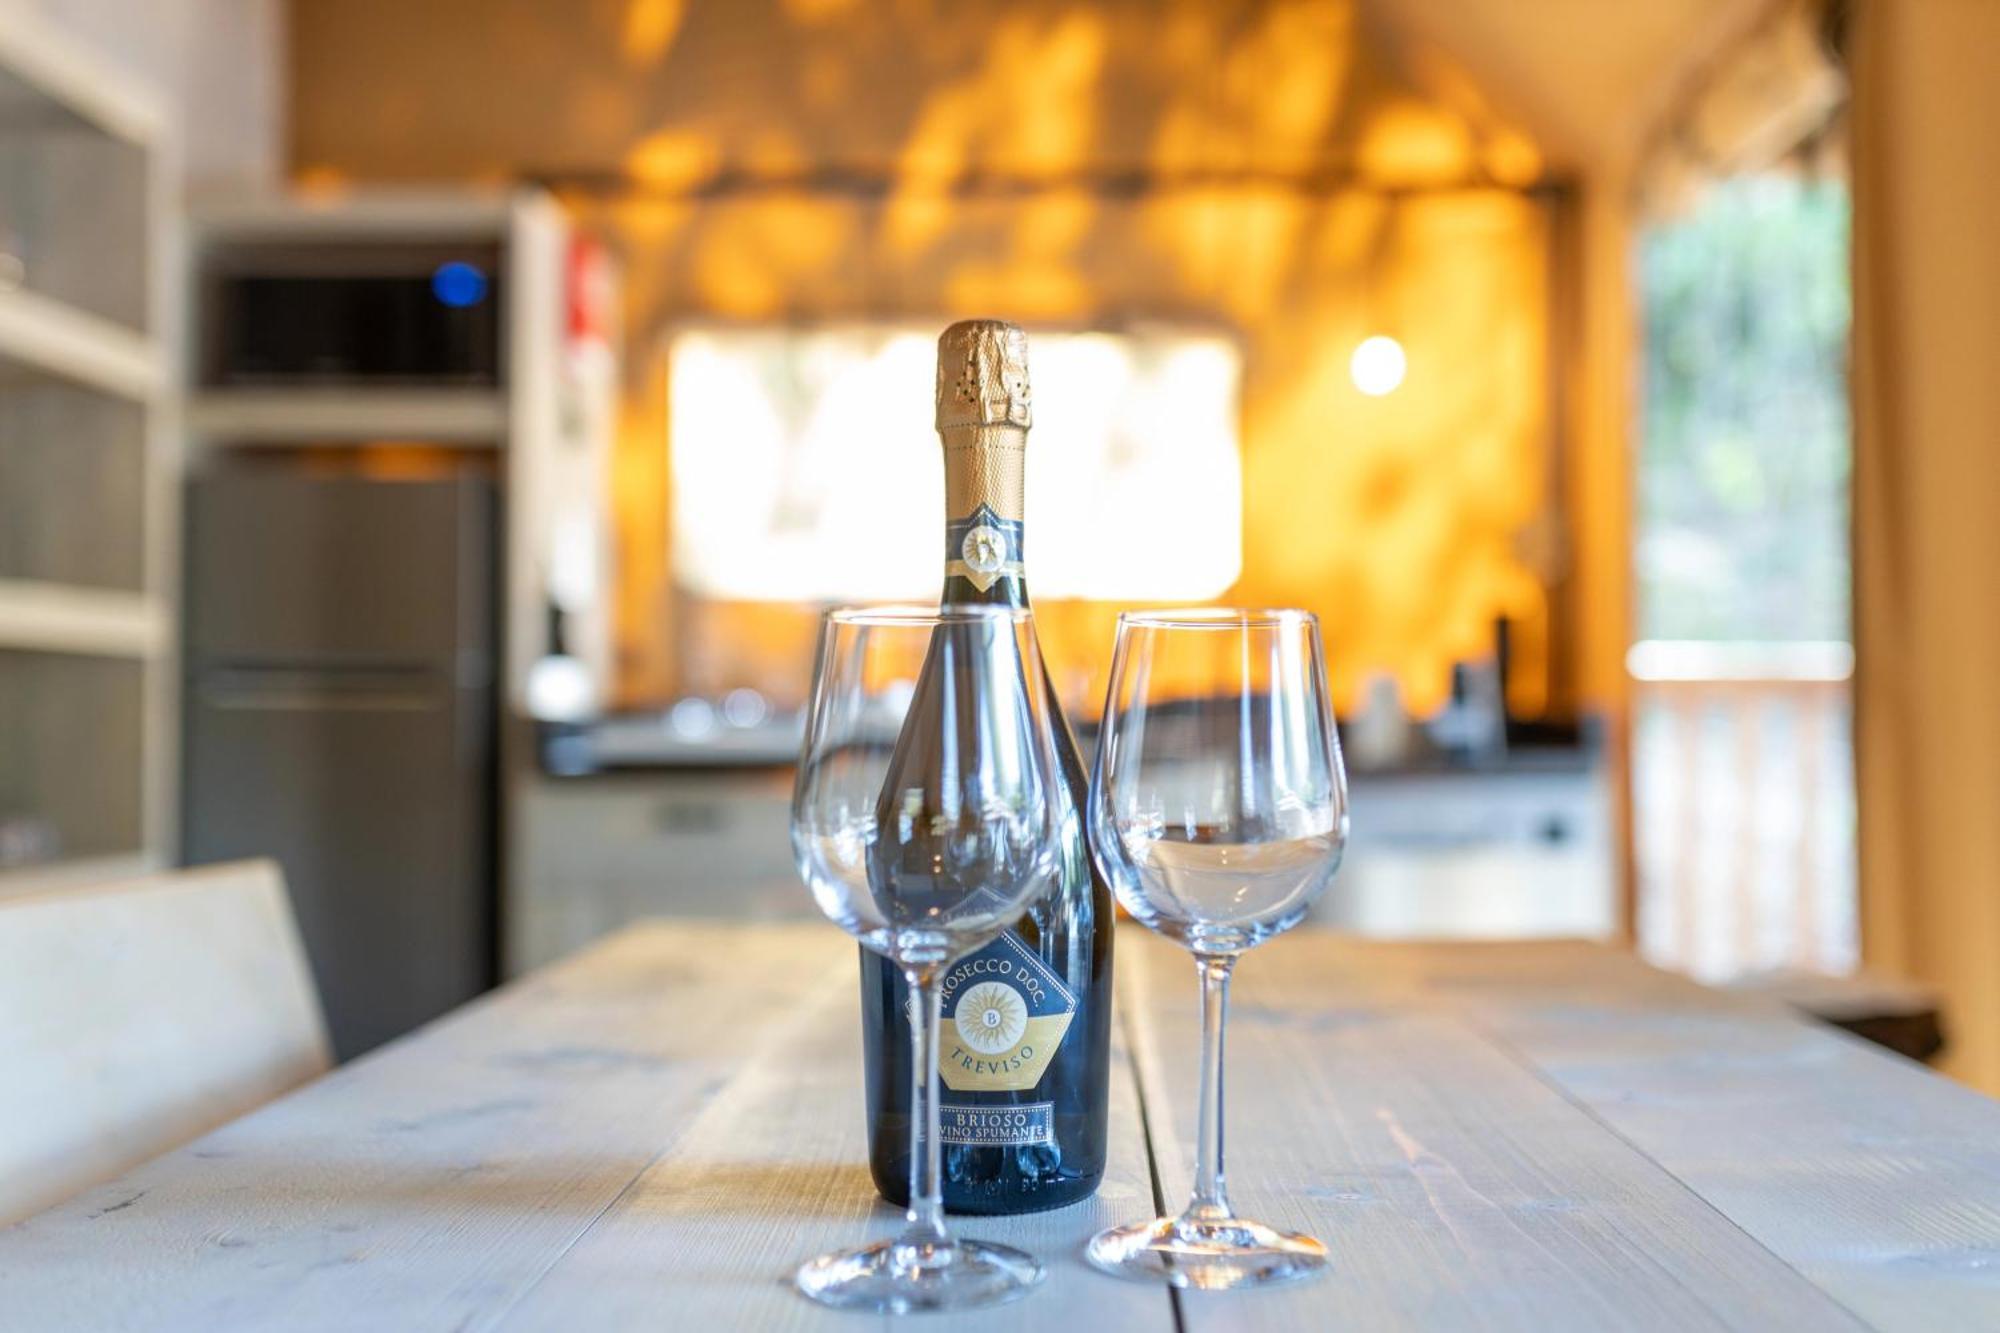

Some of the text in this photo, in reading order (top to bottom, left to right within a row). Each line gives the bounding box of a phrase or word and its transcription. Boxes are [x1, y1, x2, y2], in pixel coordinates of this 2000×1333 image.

[987, 1012, 996, 1023] B
[951, 1046, 1033, 1074] TREVISO
[957, 1114, 1026, 1126] BRIOSO
[939, 1125, 1043, 1137] VINO SPUMANTE
